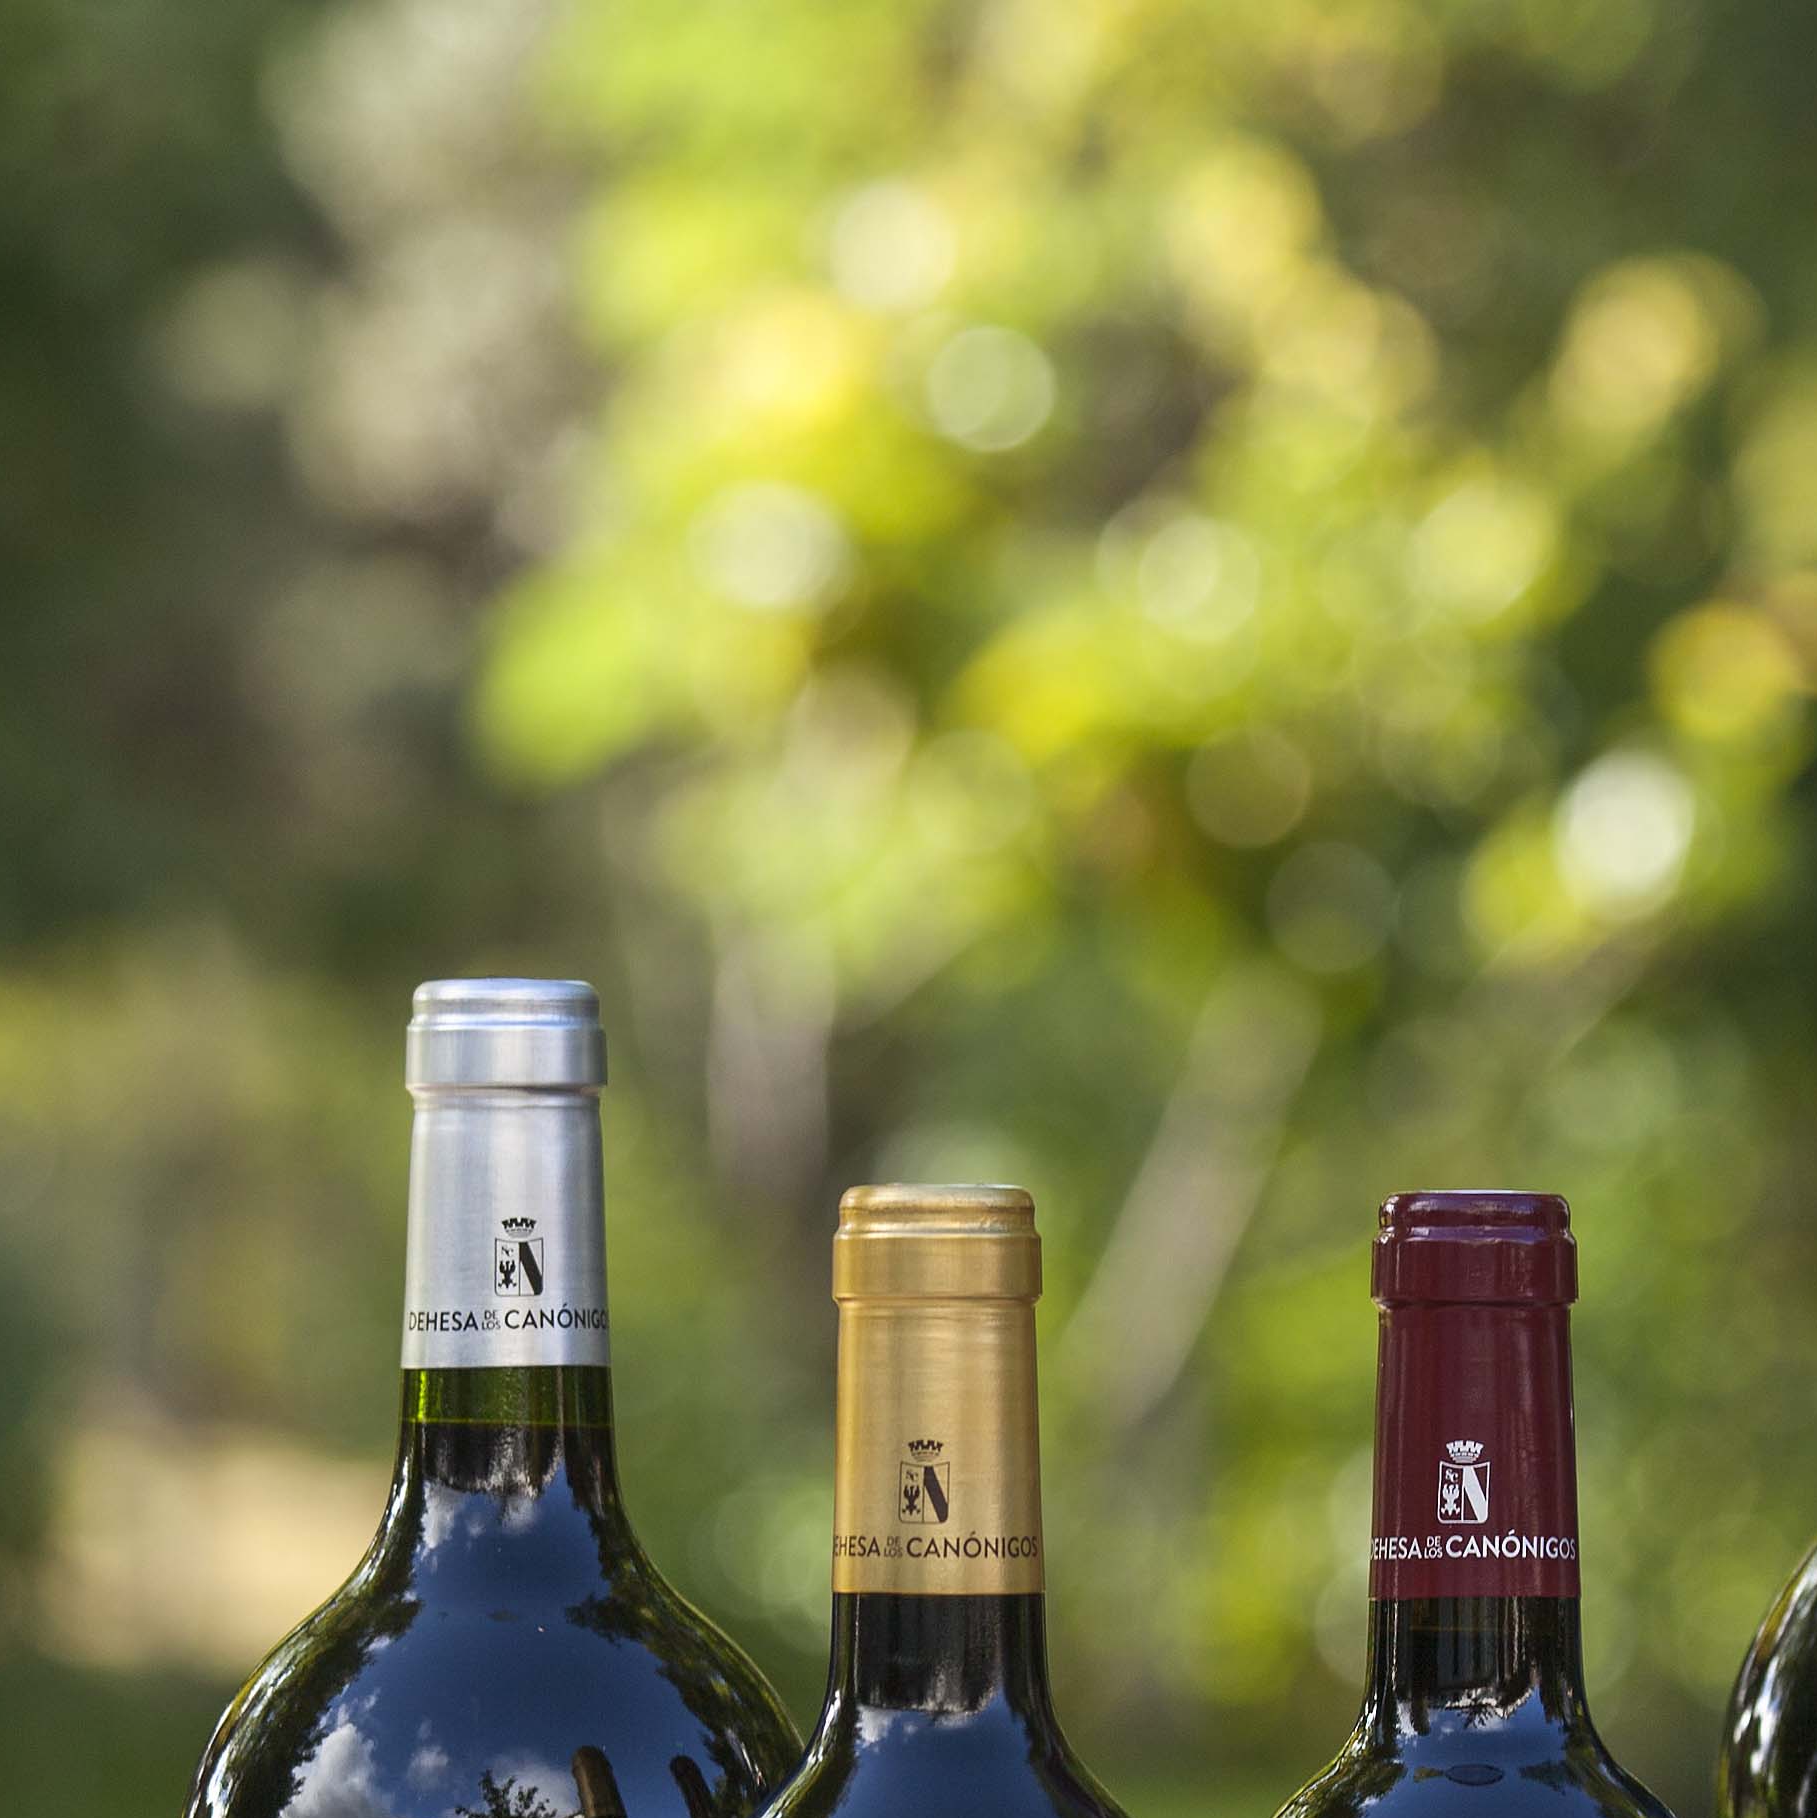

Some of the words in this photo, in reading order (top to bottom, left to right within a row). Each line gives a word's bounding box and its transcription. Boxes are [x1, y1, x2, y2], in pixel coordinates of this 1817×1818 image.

[484, 1310, 497, 1320] DE
[504, 1303, 609, 1330] CANÓNIGO
[408, 1311, 479, 1332] DEHESA
[481, 1321, 501, 1331] LOS
[886, 1536, 902, 1546] DE
[906, 1531, 1039, 1559] CANÓNIGOS
[1426, 1536, 1441, 1547] DE
[1445, 1529, 1576, 1560] CANÓNIGOS
[883, 1547, 903, 1558] LOS
[1424, 1547, 1443, 1560] LOS
